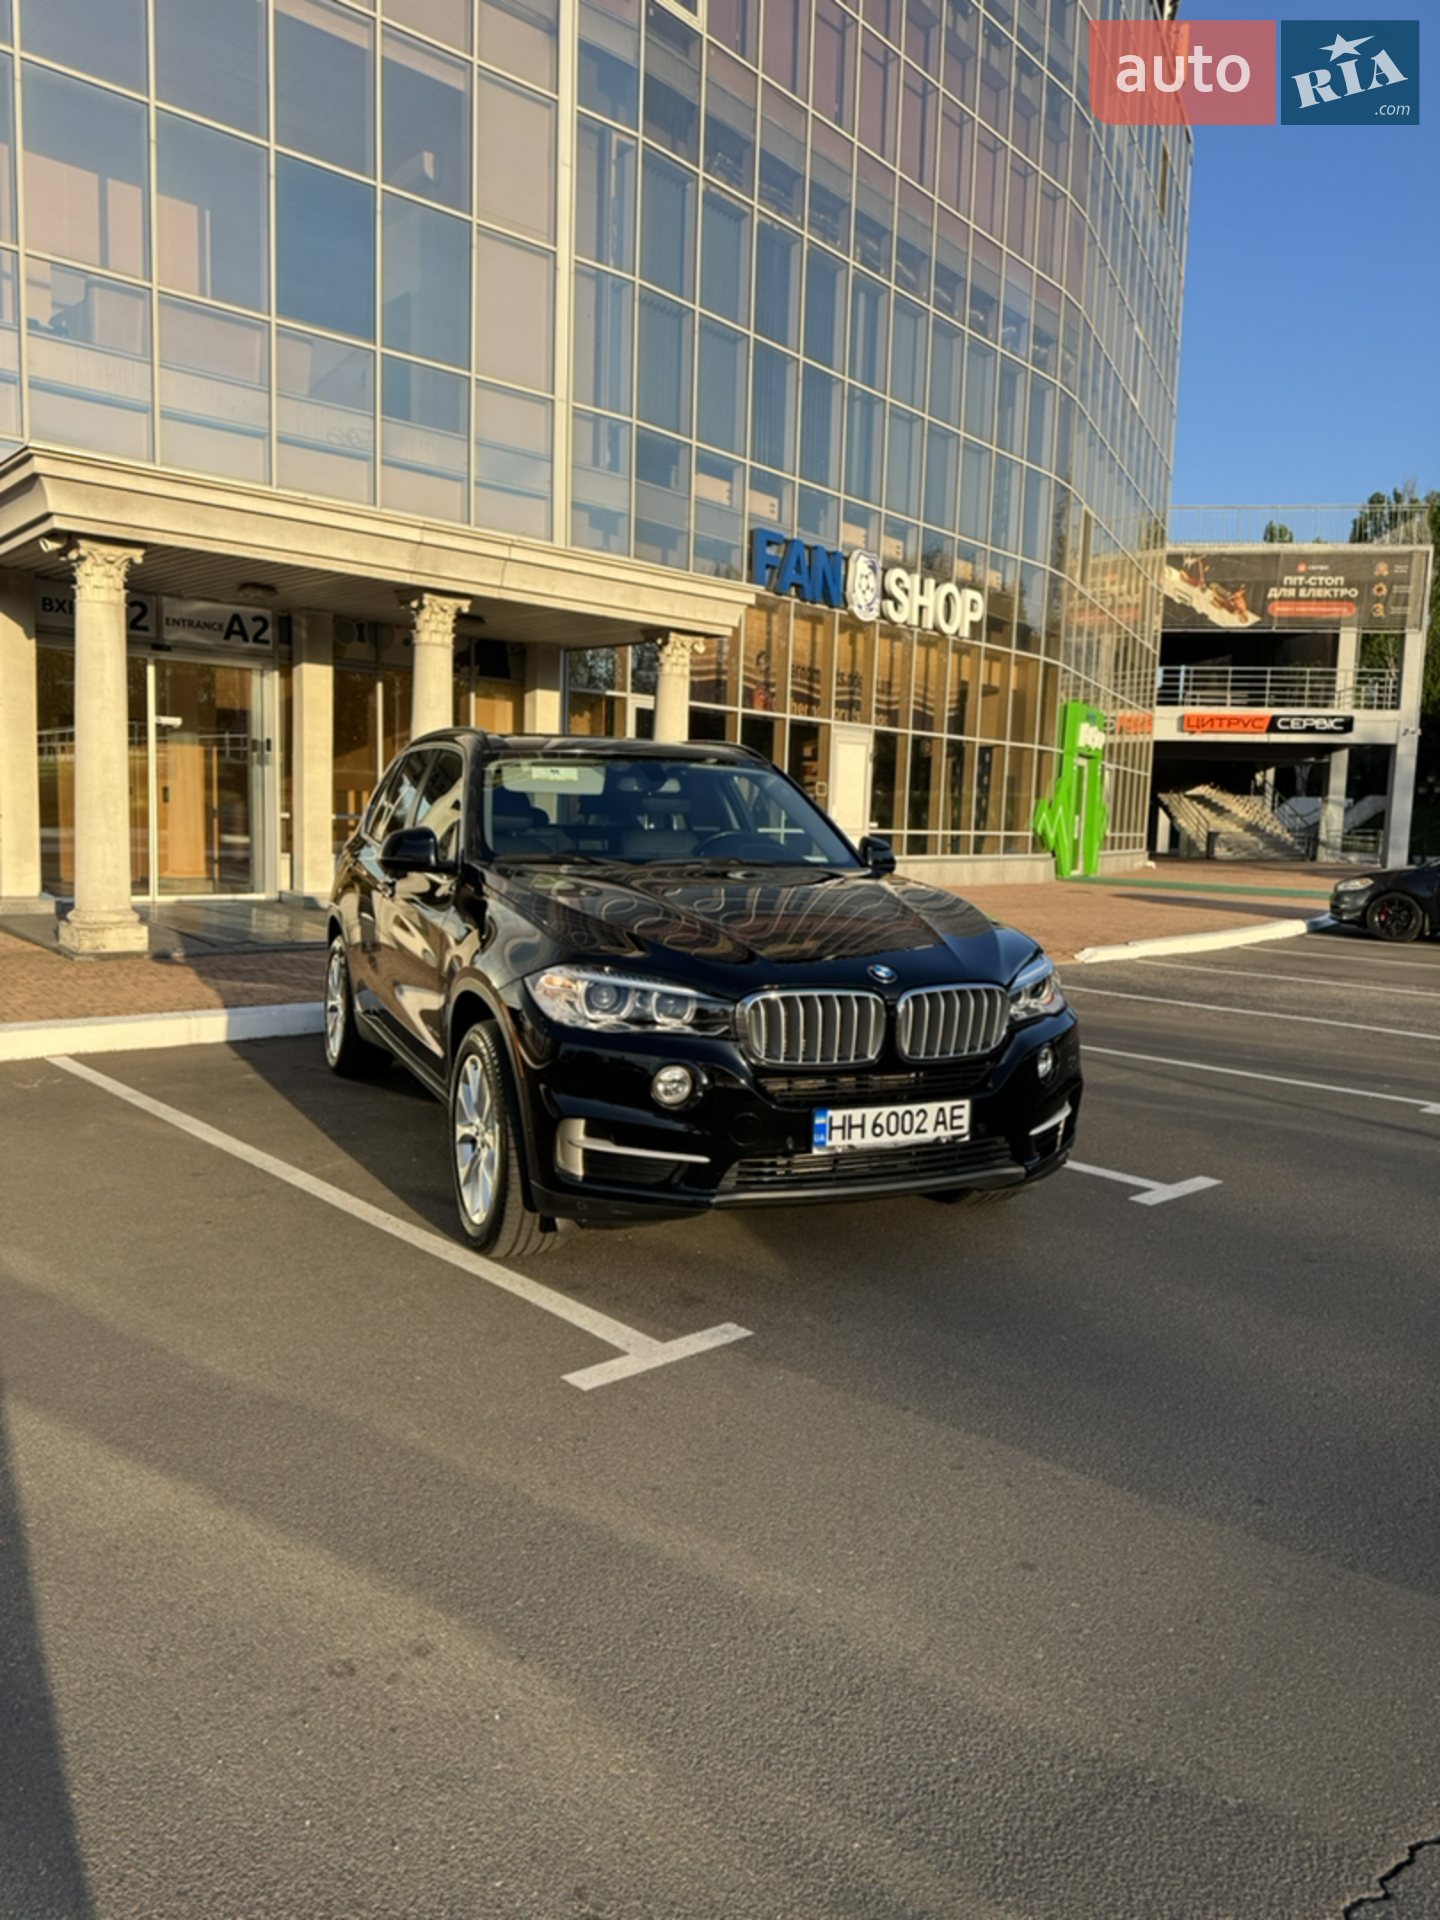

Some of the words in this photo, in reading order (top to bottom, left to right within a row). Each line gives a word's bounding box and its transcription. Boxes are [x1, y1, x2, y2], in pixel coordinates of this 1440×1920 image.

[751, 528, 844, 608] FAN
[881, 567, 984, 638] SHOP
[1283, 576, 1345, 586] ПІТ-СТОП
[1267, 587, 1296, 599] ДЛЯ
[1298, 587, 1359, 599] ЕЛЕКТРО
[165, 617, 224, 632] ENTRANCE
[223, 613, 271, 644] A2
[1186, 716, 1265, 731] ЦИТРУС
[1276, 717, 1346, 731] СЕРВІС
[828, 1113, 866, 1141] HH
[870, 1108, 928, 1138] 6002
[933, 1104, 965, 1132] AE
